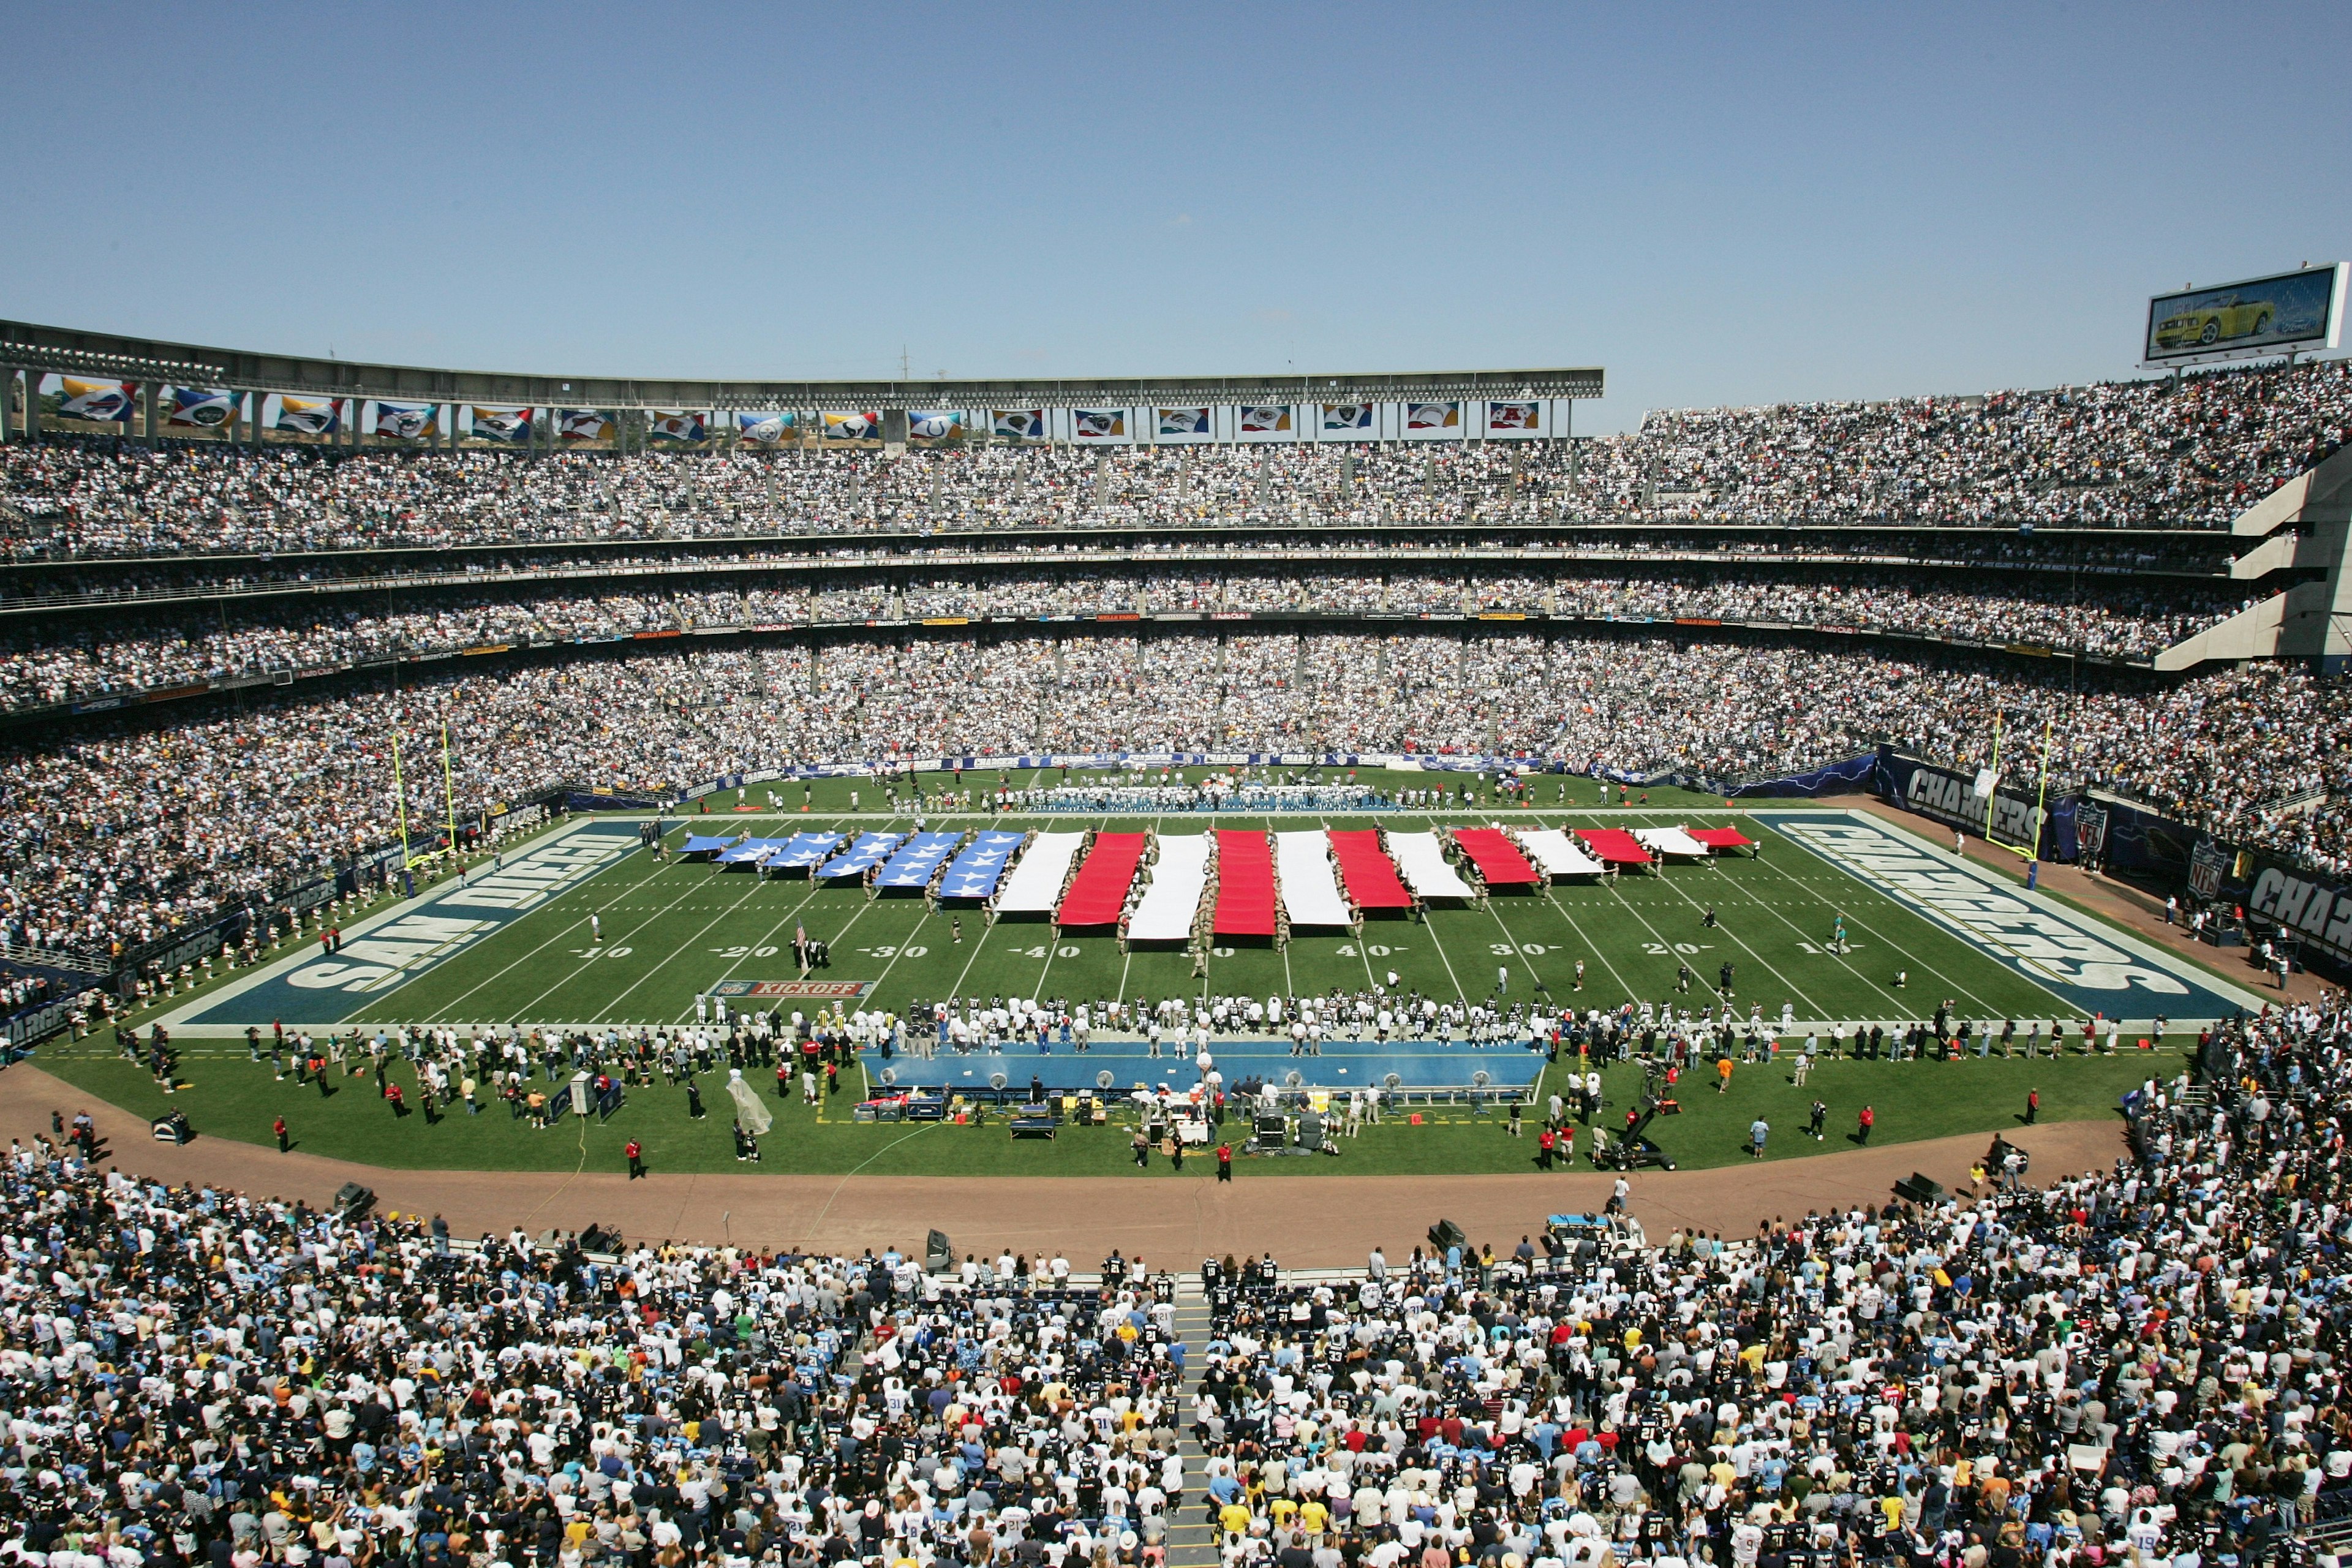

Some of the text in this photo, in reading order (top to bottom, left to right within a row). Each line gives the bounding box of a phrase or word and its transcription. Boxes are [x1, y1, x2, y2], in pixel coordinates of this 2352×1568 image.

[2282, 322, 2310, 333] Ford
[420, 652, 453, 661] MasterCard
[91, 698, 121, 709] PEPSI
[973, 758, 1019, 767] CHARGERS
[2076, 822, 2100, 849] NFL
[2190, 863, 2215, 893] NFL
[286, 834, 641, 993] SAN DIEGO
[1777, 822, 2190, 995] CHARGERS
[578, 946, 634, 959] 10
[719, 946, 778, 958] 20
[871, 946, 929, 958] 30
[1025, 946, 1080, 958] 40
[1335, 944, 1391, 957] 40
[1488, 943, 1545, 956] 30
[1642, 943, 1699, 955] 20
[757, 984, 856, 994] KICKOFF
[886, 1261, 895, 1270] 21
[1111, 1264, 1119, 1273] 21
[1586, 1267, 1594, 1276] 21
[1512, 1273, 1520, 1282] 31
[1218, 1293, 1227, 1303] 31
[976, 1329, 983, 1339] 9
[1146, 1331, 1156, 1341] 21
[818, 1341, 828, 1352] 21
[809, 1357, 817, 1366] 21
[1329, 1351, 1342, 1362] 33
[409, 1360, 417, 1370] 21
[937, 1361, 946, 1370] 31
[646, 1378, 657, 1387] 14
[799, 1376, 812, 1385] 76
[1090, 1392, 1099, 1401] 21
[890, 1399, 900, 1408] 31
[1619, 1402, 1623, 1411] 9
[1405, 1419, 1416, 1429] 21
[1642, 1428, 1654, 1439] 21
[1964, 1425, 1980, 1437] 85
[559, 1434, 570, 1445] 21
[1018, 1434, 1027, 1445] 31
[904, 1449, 916, 1461] 21
[1441, 1458, 1452, 1469] 21
[1009, 1521, 1019, 1530] 21
[1648, 1523, 1662, 1536] 21
[1109, 1526, 1120, 1537] 21
[1747, 1540, 1752, 1550] 9
[2139, 1537, 2154, 1549] 19
[2205, 1534, 2214, 1545] 8
